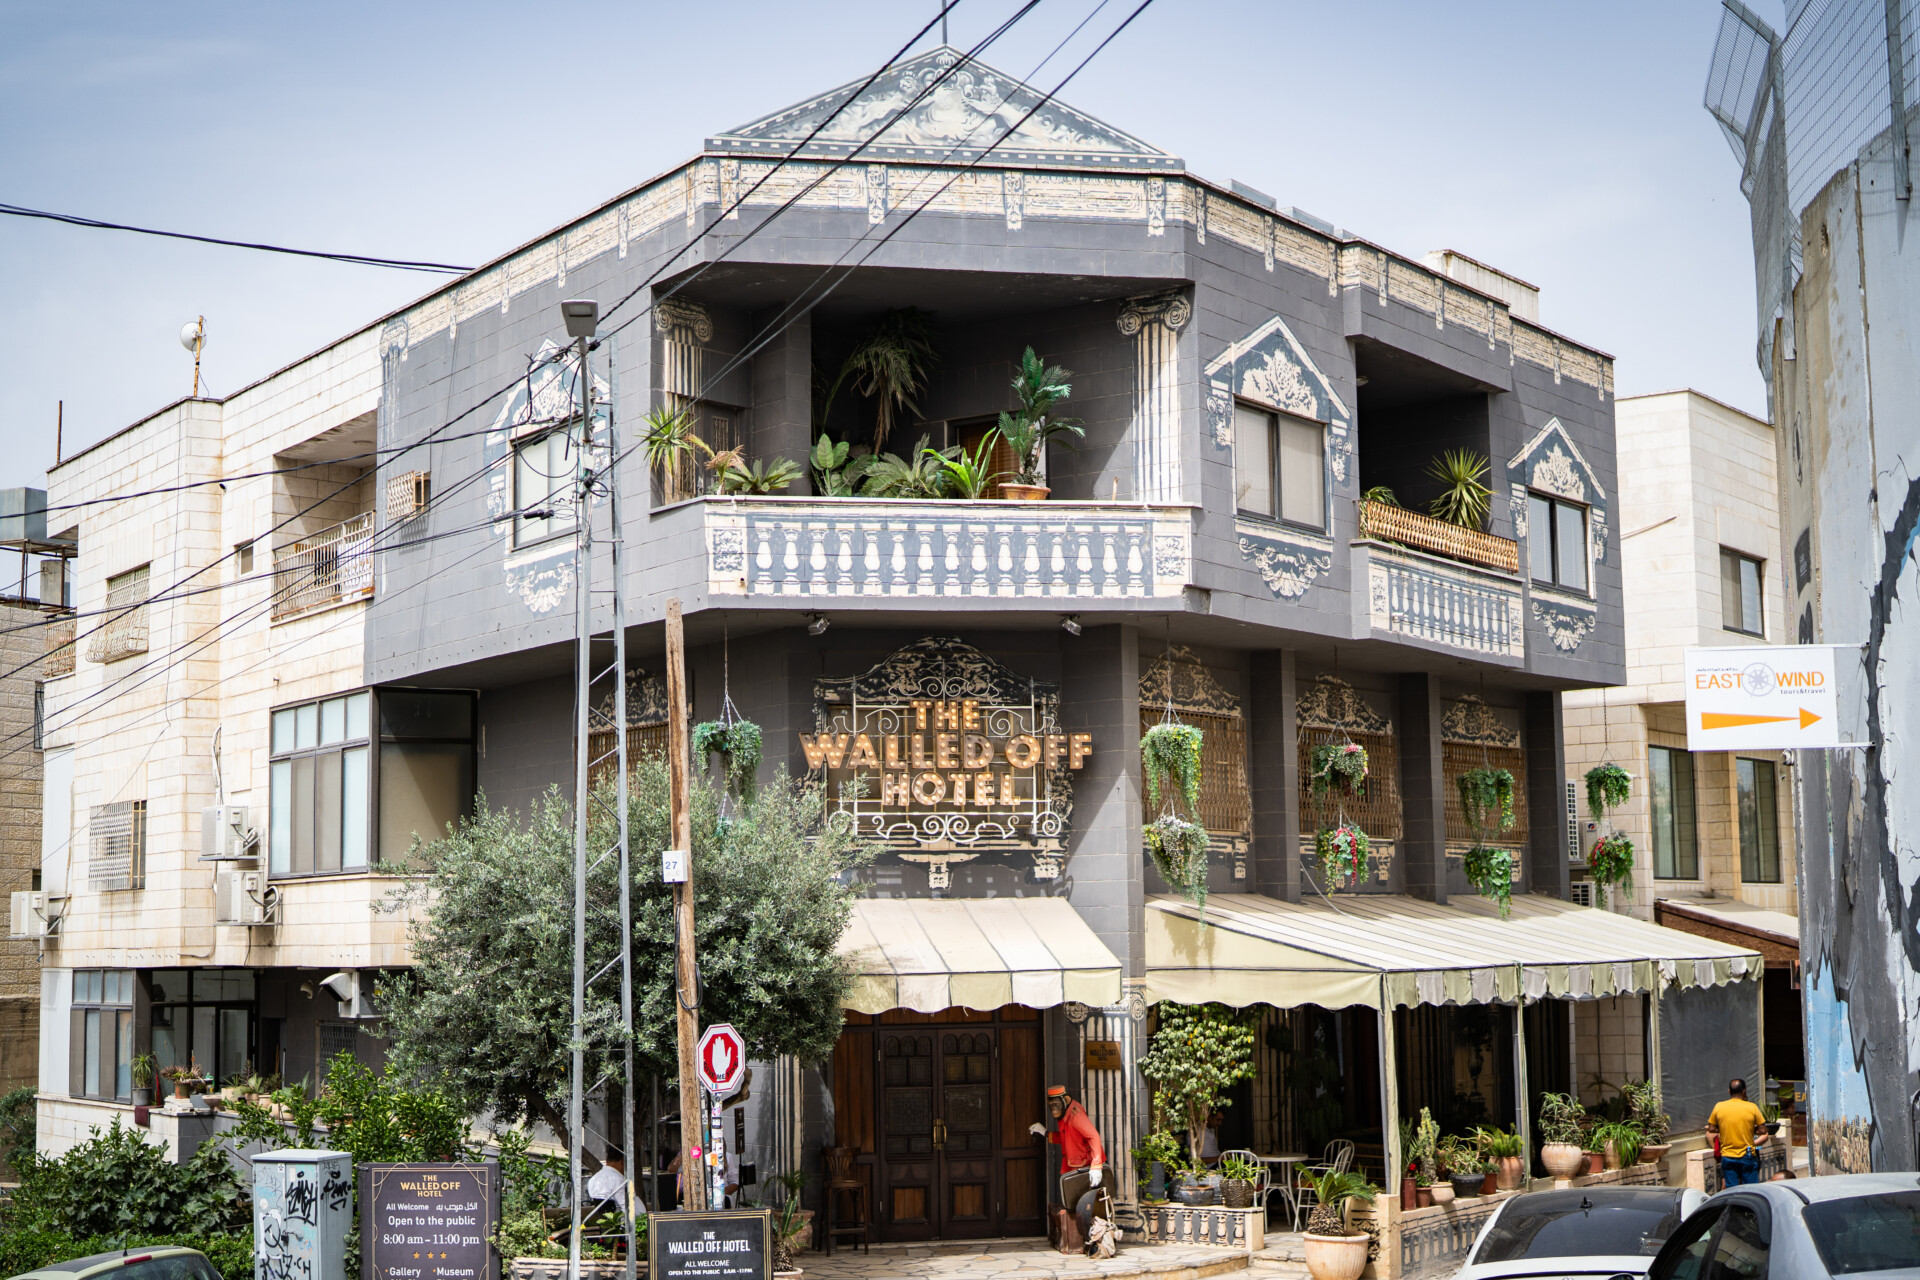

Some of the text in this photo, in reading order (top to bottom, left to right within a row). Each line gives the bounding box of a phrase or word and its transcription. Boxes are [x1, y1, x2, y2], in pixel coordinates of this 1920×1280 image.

[1695, 671, 1825, 689] EAST WIND
[910, 700, 980, 730] THE
[799, 732, 1092, 769] WALLED OFF
[881, 771, 1021, 806] HOTEL
[665, 861, 677, 870] 27
[703, 1061, 715, 1079] GIVE
[727, 1060, 739, 1078] FIVE
[422, 1174, 438, 1182] THE
[400, 1182, 461, 1190] WALLED OFF
[397, 1203, 429, 1211] Welcome
[444, 1204, 463, 1212] مرحب
[464, 1202, 478, 1211] الكل
[388, 1216, 476, 1227] Open to the public
[383, 1234, 405, 1244] 8:00
[407, 1236, 423, 1244] am
[433, 1234, 460, 1244] 11:00
[462, 1236, 480, 1246] pm
[703, 1231, 716, 1240] THE
[668, 1240, 750, 1254] WALLED OFF HOTEL
[389, 1267, 421, 1278] Gallery
[436, 1267, 474, 1276] Museum
